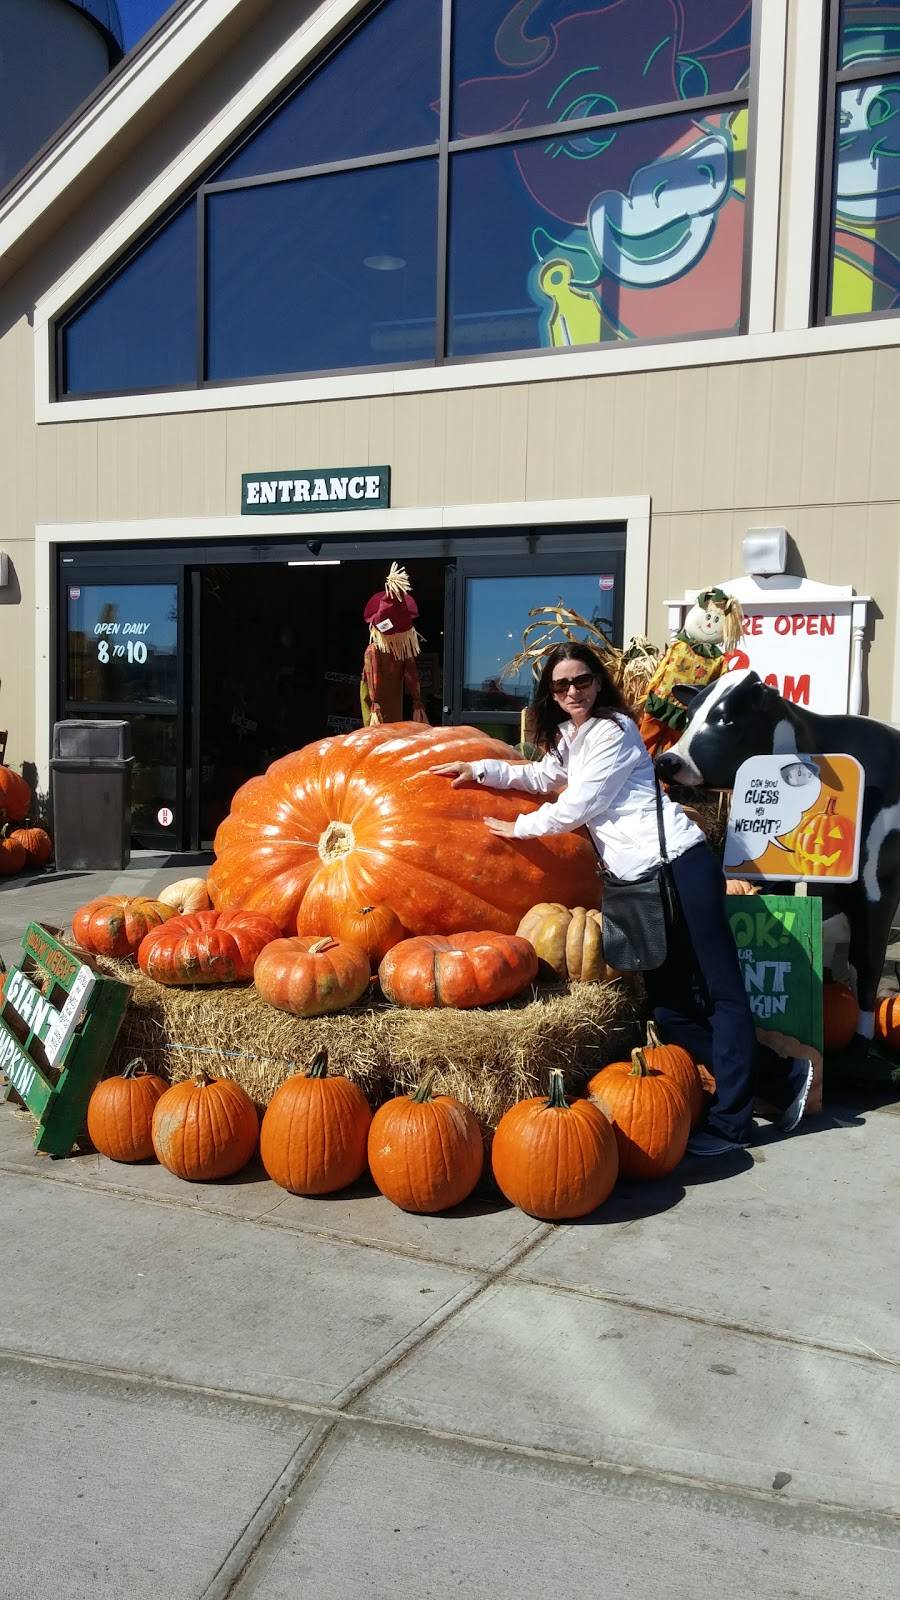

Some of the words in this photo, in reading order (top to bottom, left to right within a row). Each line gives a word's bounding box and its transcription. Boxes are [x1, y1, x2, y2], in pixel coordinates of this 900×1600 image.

[246, 475, 380, 504] ENTRANCE
[93, 622, 121, 635] OPEN
[122, 622, 151, 635] DAILY
[742, 614, 764, 636] RE
[774, 613, 835, 636] OPEN
[97, 640, 110, 664] 8
[112, 645, 126, 657] TO
[126, 640, 148, 664] 10
[750, 778, 763, 788] CAN
[764, 779, 779, 789] YOU
[744, 789, 780, 805] GUESS
[734, 818, 782, 835] WEIGHT?
[740, 960, 792, 994] NT
[0, 1024, 37, 1101] MPKIN!
